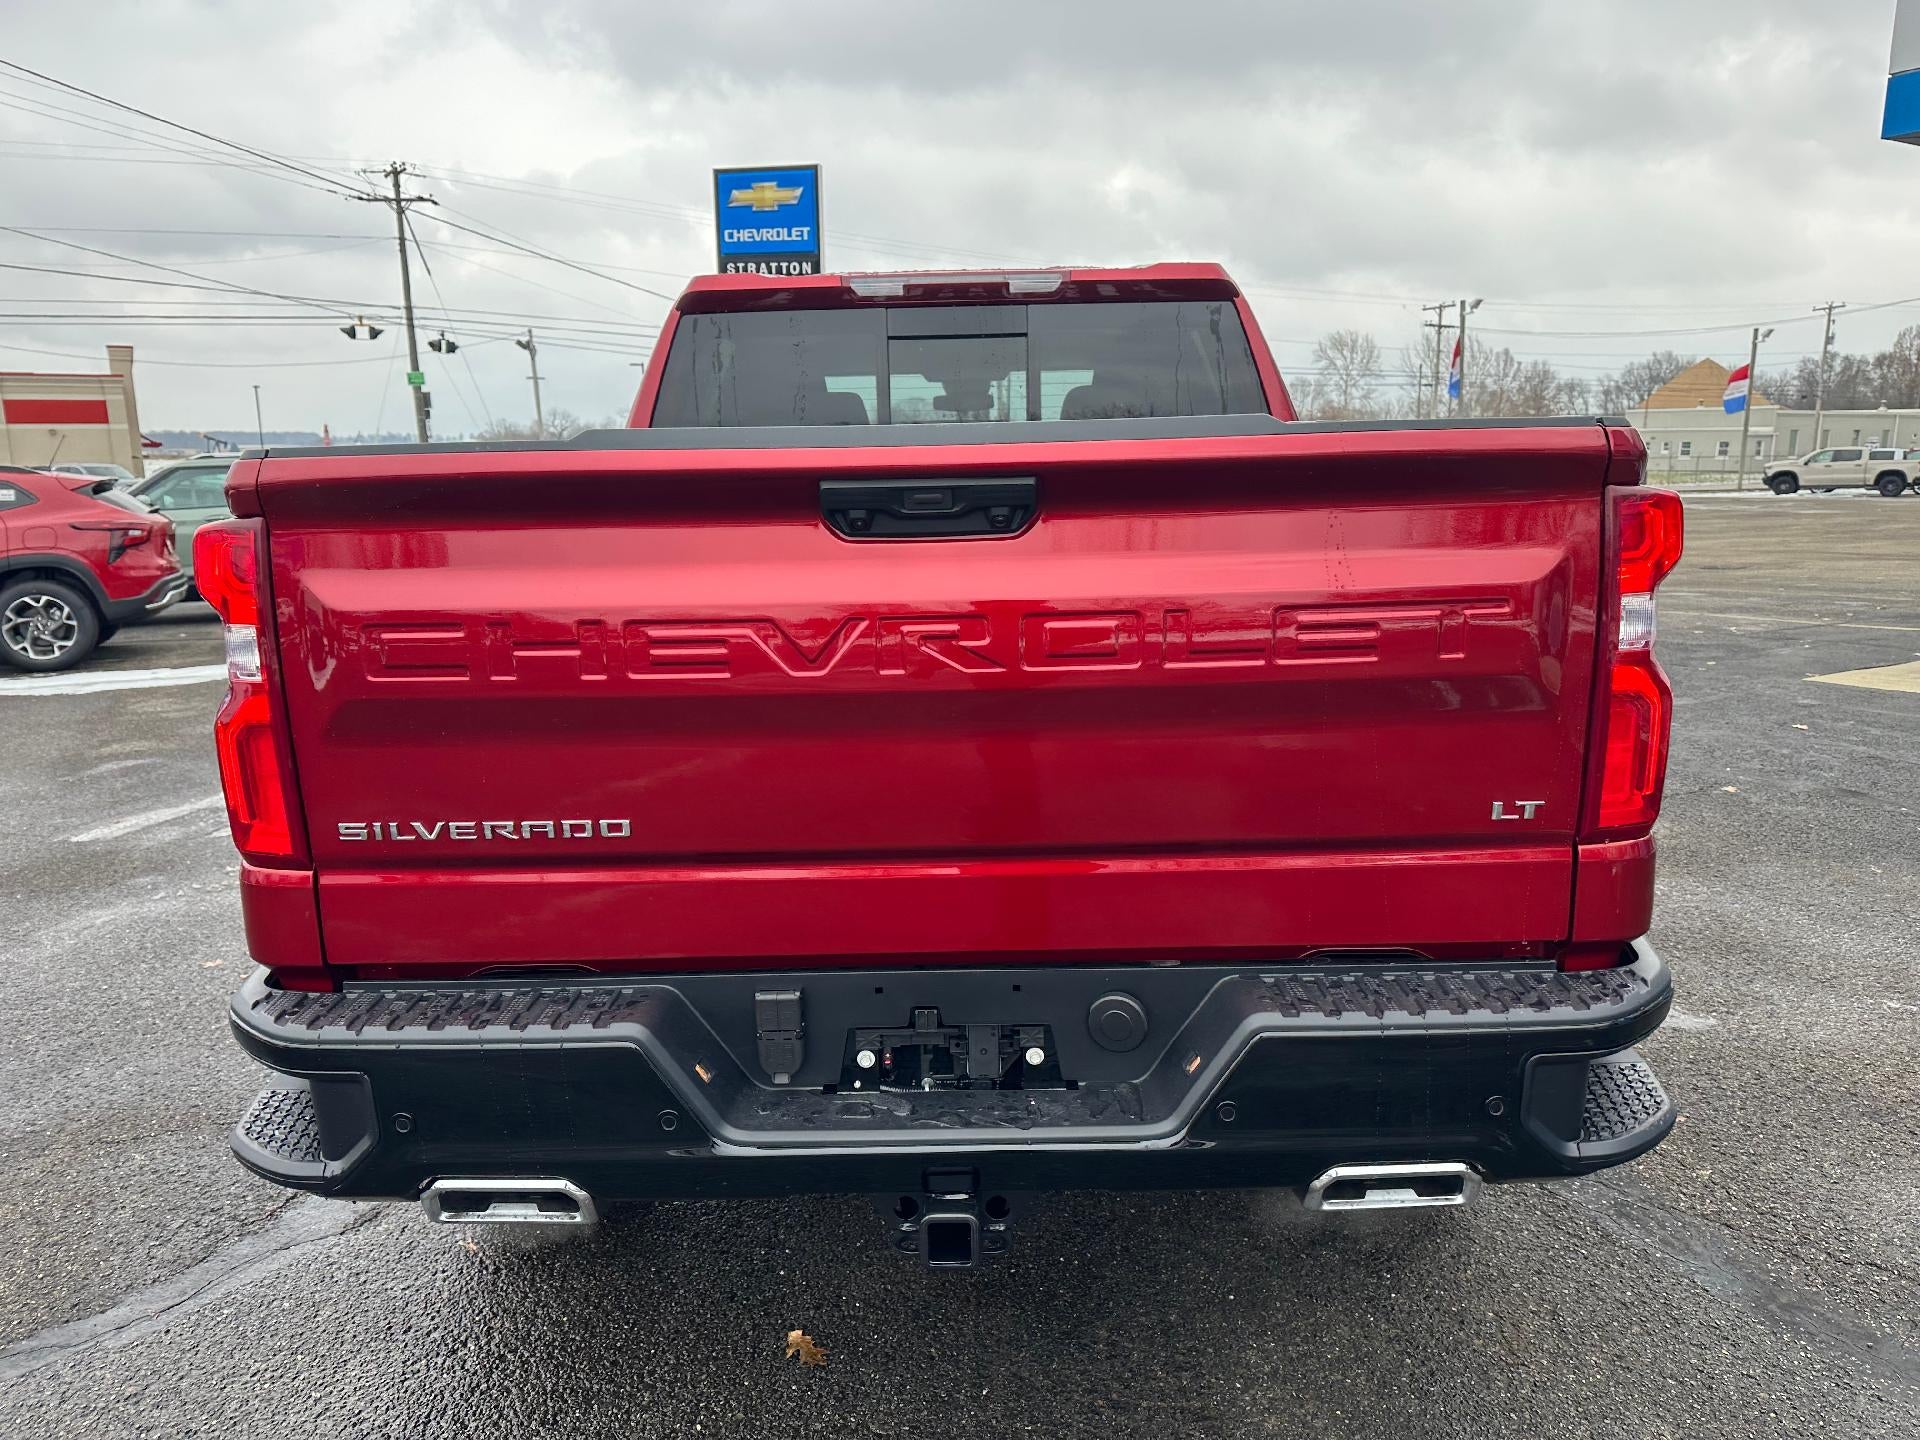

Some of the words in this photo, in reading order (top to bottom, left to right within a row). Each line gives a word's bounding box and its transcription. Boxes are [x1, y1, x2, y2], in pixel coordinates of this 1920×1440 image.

[723, 227, 811, 243] CHEVROLET
[726, 261, 812, 275] STRATTON
[361, 597, 1512, 681] CHEVROLET
[1491, 800, 1546, 820] LT
[337, 819, 632, 841] SILVERADO
